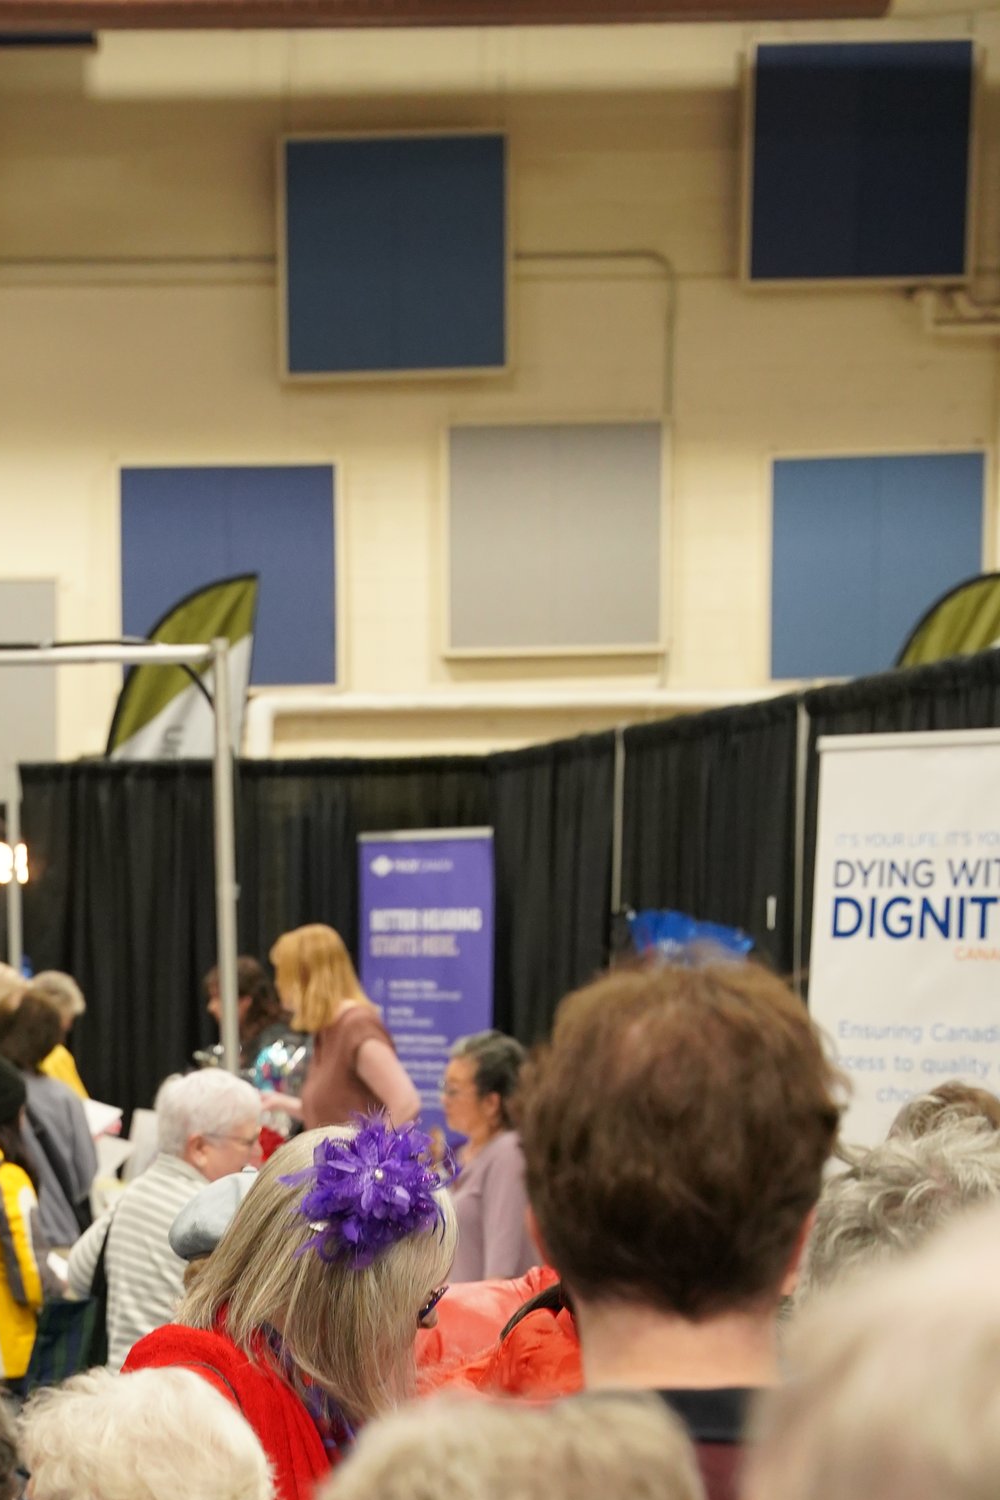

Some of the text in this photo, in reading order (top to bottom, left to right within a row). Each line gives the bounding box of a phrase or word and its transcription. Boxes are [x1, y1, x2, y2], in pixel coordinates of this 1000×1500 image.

[864, 831, 904, 848] YOUR
[833, 858, 936, 889] DYING
[832, 896, 999, 940] DIGNIT
[838, 1019, 923, 1045] Ensuring
[893, 1056, 914, 1073] to
[920, 1056, 991, 1080] quality
